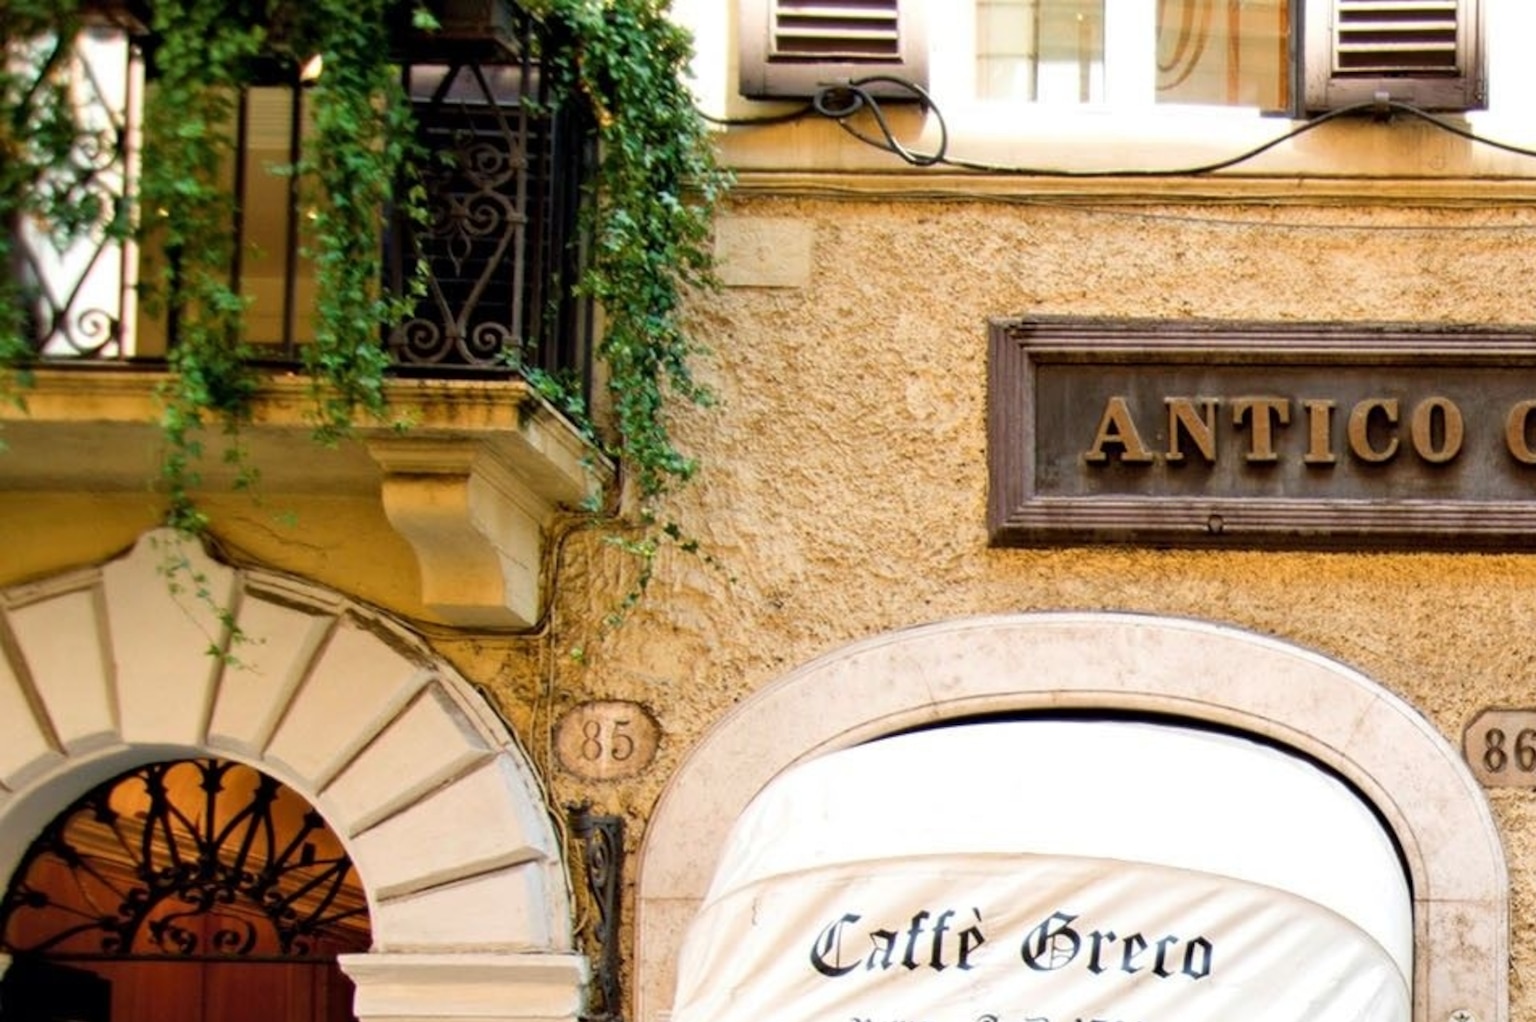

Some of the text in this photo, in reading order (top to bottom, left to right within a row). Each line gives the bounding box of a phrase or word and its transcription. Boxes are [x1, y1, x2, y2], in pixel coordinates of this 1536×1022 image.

[1085, 397, 1463, 464] ANTICO
[581, 719, 635, 761] 85
[809, 907, 1214, 981] Caffè Greco
